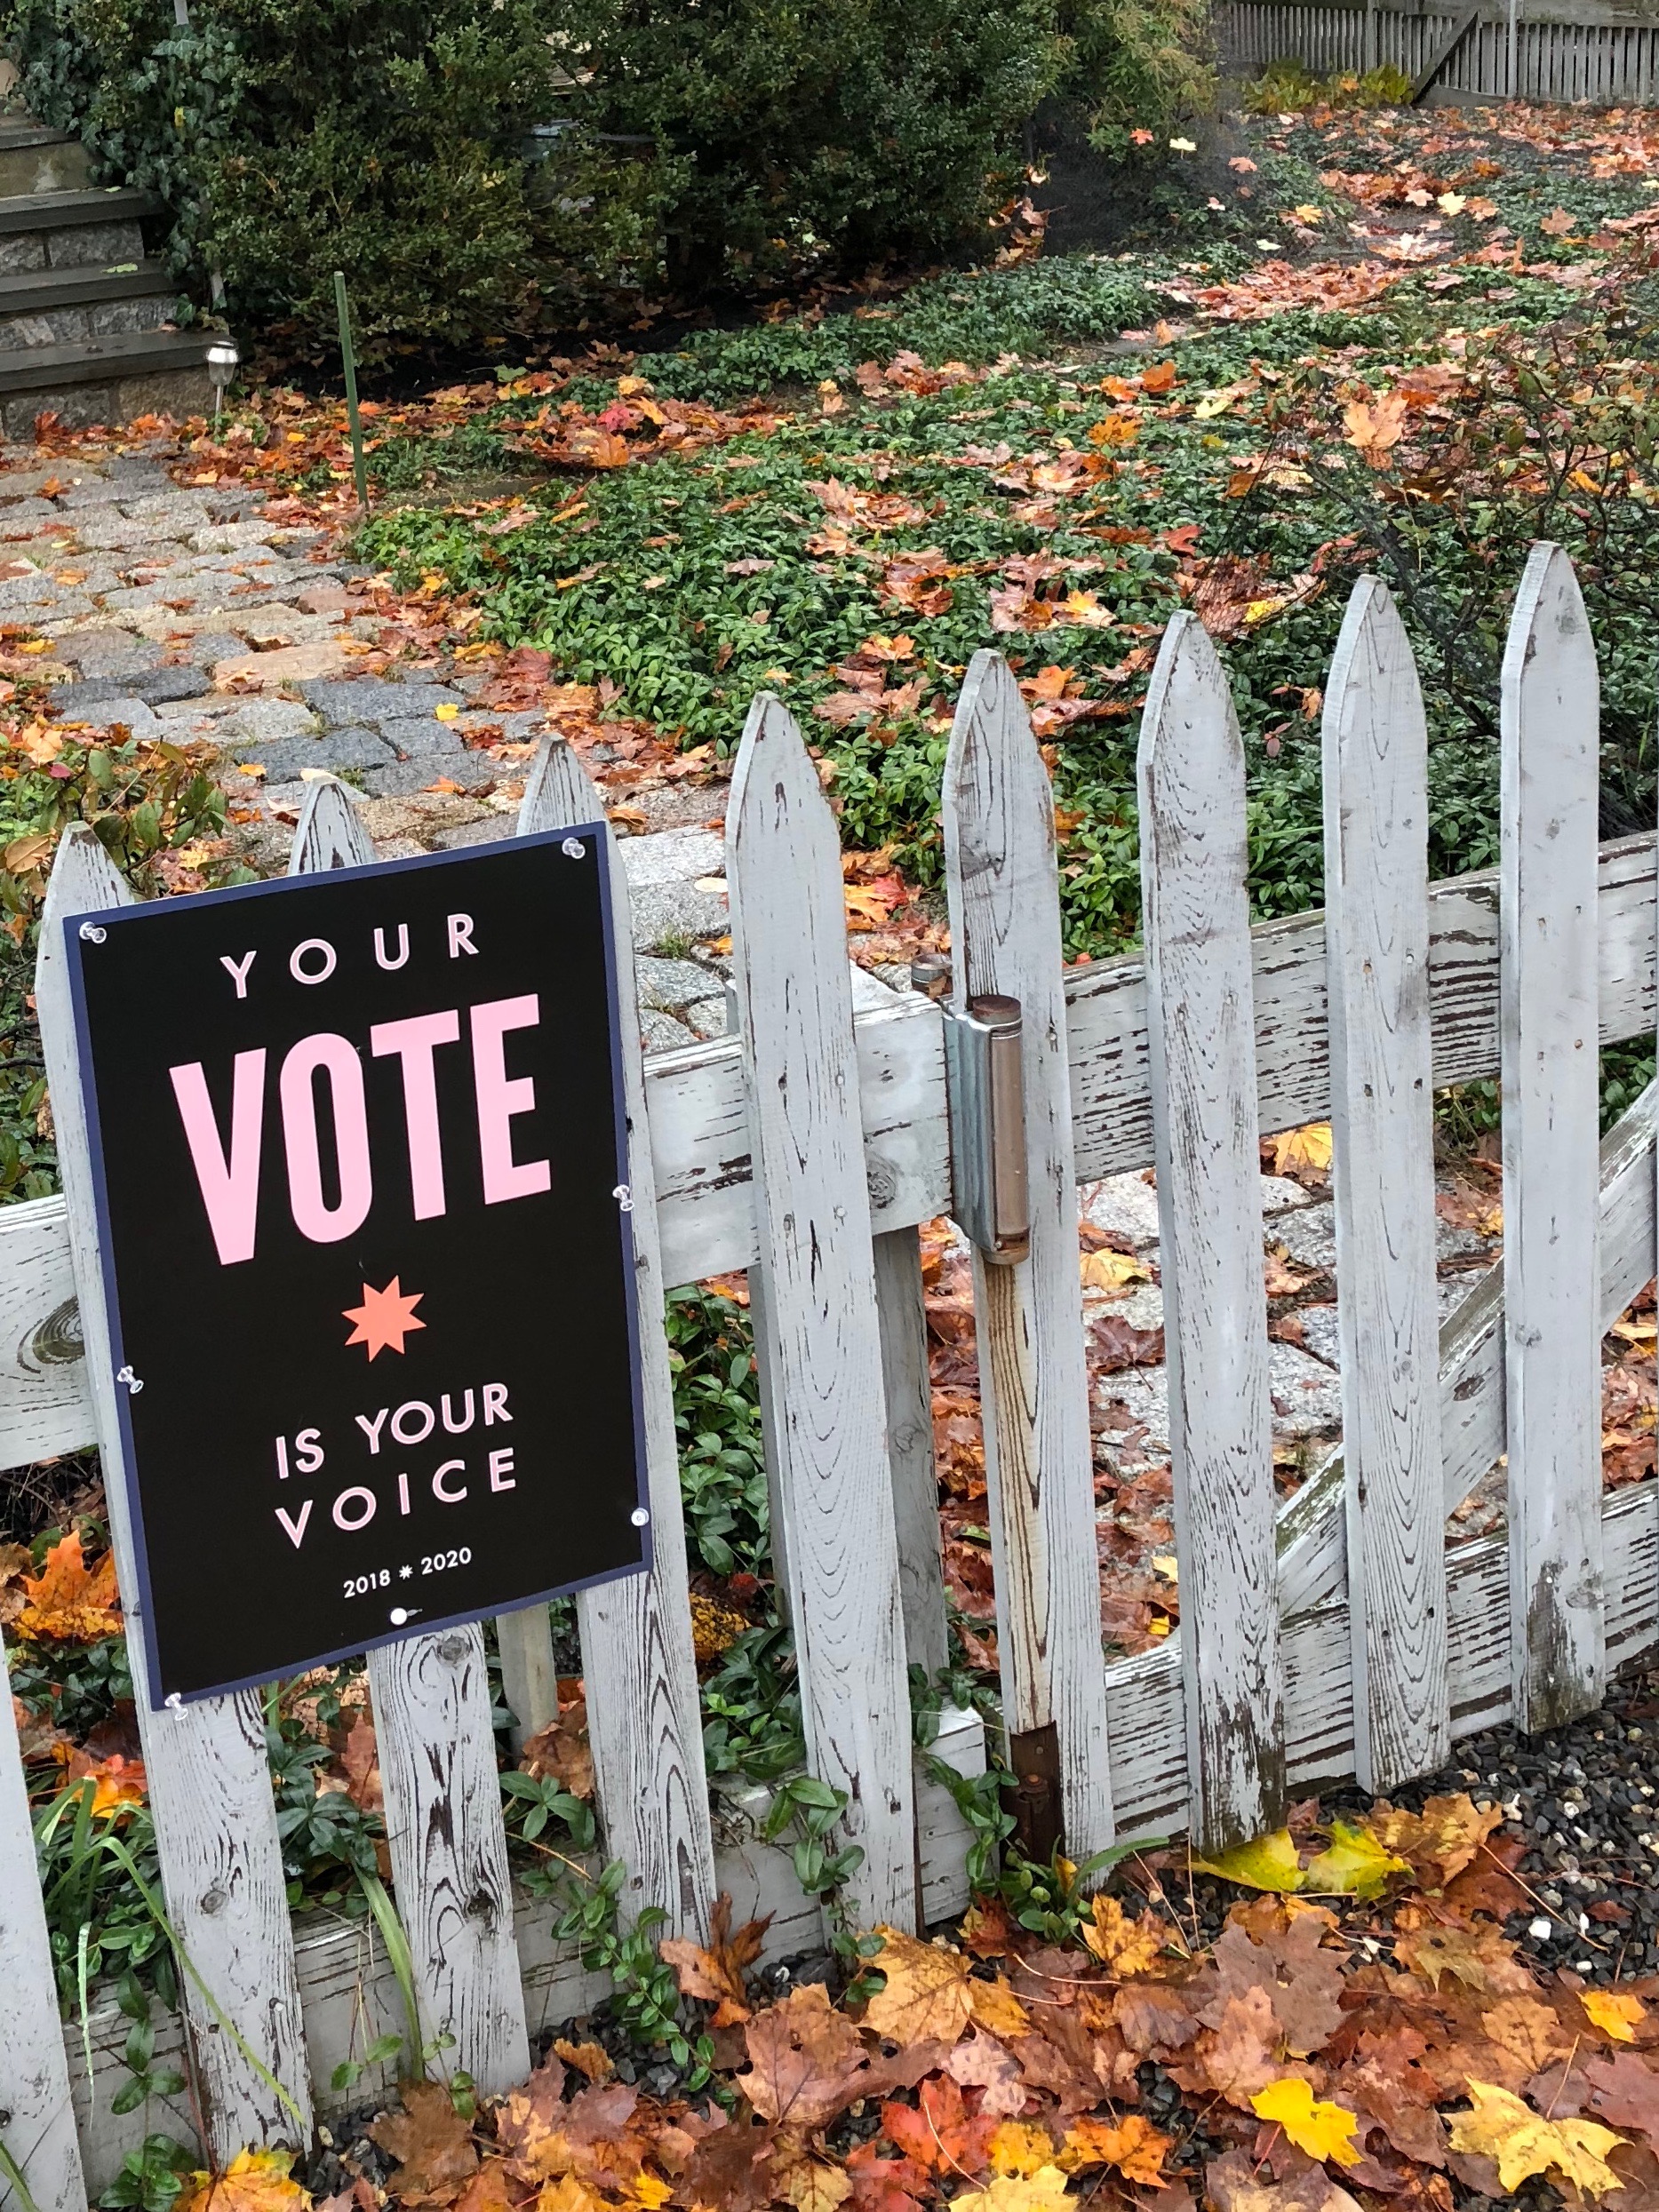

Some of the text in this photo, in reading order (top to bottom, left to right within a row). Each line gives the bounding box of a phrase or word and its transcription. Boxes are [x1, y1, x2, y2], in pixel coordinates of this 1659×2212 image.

[219, 913, 481, 999] YOUR
[168, 993, 552, 1266] VOTE
[275, 1382, 514, 1480] IS YOUR
[274, 1446, 517, 1549] VOICE
[343, 1547, 473, 1599] 2018 2020
